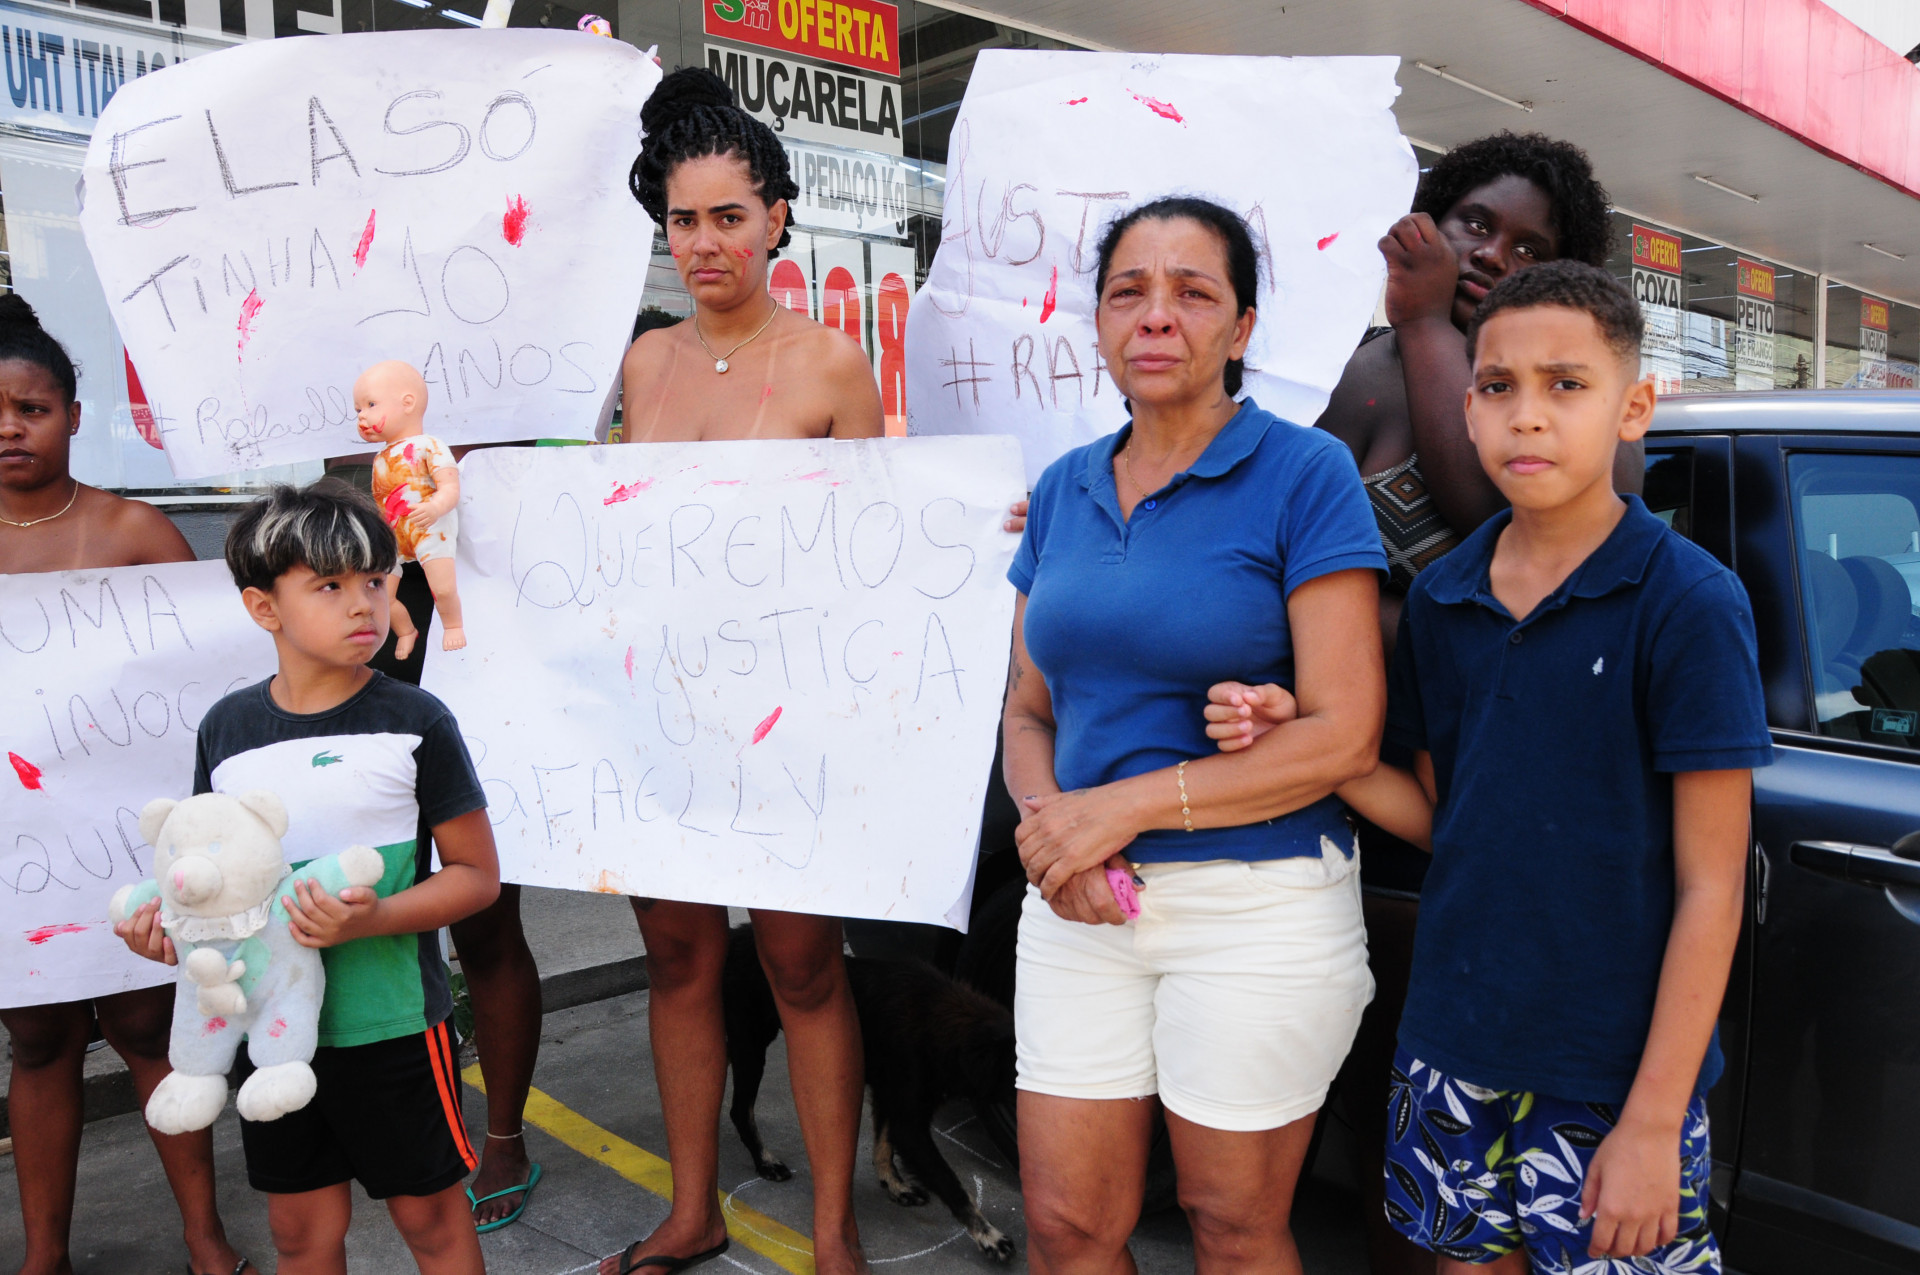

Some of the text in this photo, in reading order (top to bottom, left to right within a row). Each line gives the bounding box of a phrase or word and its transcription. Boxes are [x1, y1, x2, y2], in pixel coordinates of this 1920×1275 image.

[2, 25, 64, 113] UHT
[706, 47, 901, 139] MUÇARELA
[804, 152, 878, 230] PEDAÇO
[881, 166, 906, 236] Kg
[1649, 236, 1679, 269] OFERTA
[1632, 270, 1679, 310] COXA
[1737, 298, 1774, 335] PEITO
[423, 336, 597, 403] ANOS
[1736, 335, 1747, 355] DE
[511, 491, 976, 610] QUEREMOS
[0, 574, 195, 656] UMA
